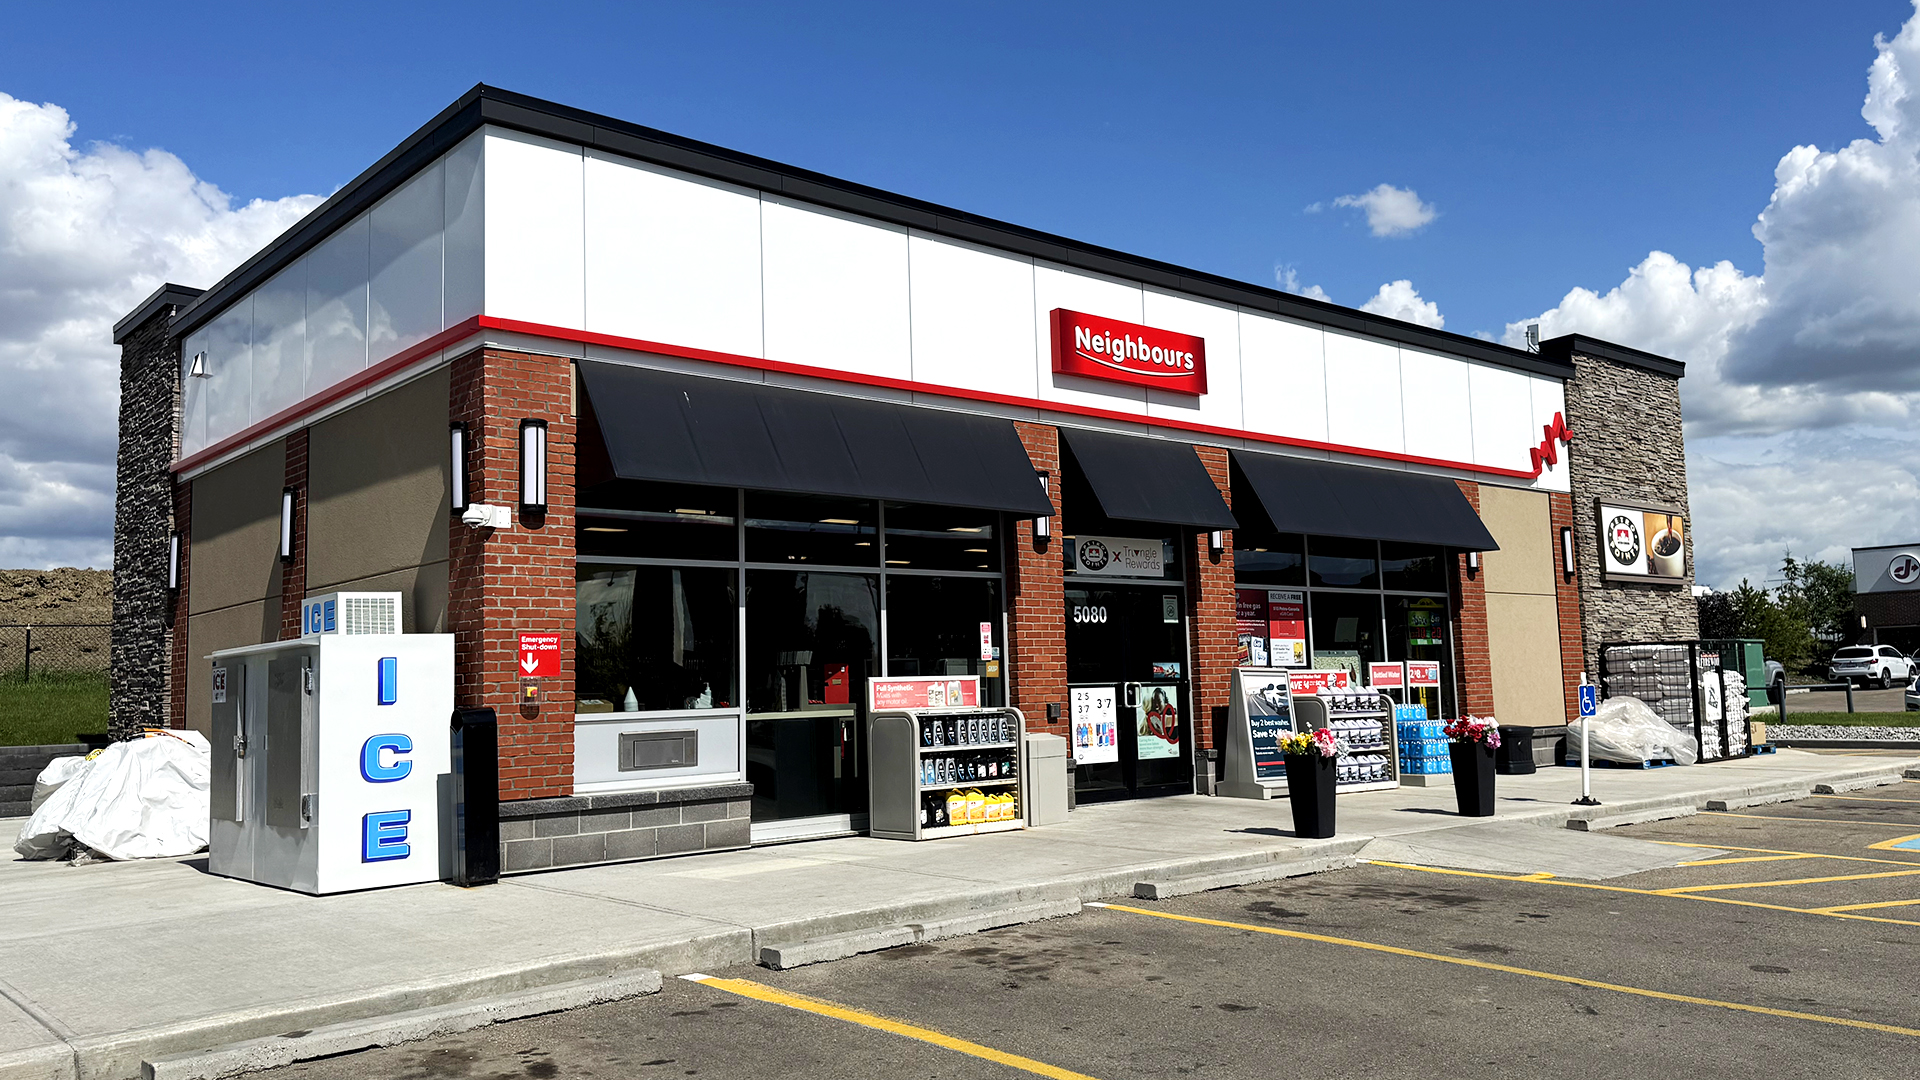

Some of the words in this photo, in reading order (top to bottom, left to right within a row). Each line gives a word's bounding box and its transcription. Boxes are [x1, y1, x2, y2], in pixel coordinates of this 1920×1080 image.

[1074, 325, 1194, 370] Neighbours
[1611, 516, 1636, 532] PETRO
[1610, 541, 1639, 560] POINTS
[1126, 558, 1160, 570] Rewards
[304, 600, 336, 635] ICE
[1074, 606, 1107, 623] 5080
[521, 636, 558, 644] Emergency
[212, 670, 226, 691] ICE
[887, 684, 914, 692] Synthetic
[1251, 719, 1260, 727] Buy
[1252, 729, 1268, 738] Save
[360, 657, 413, 864] ICE
